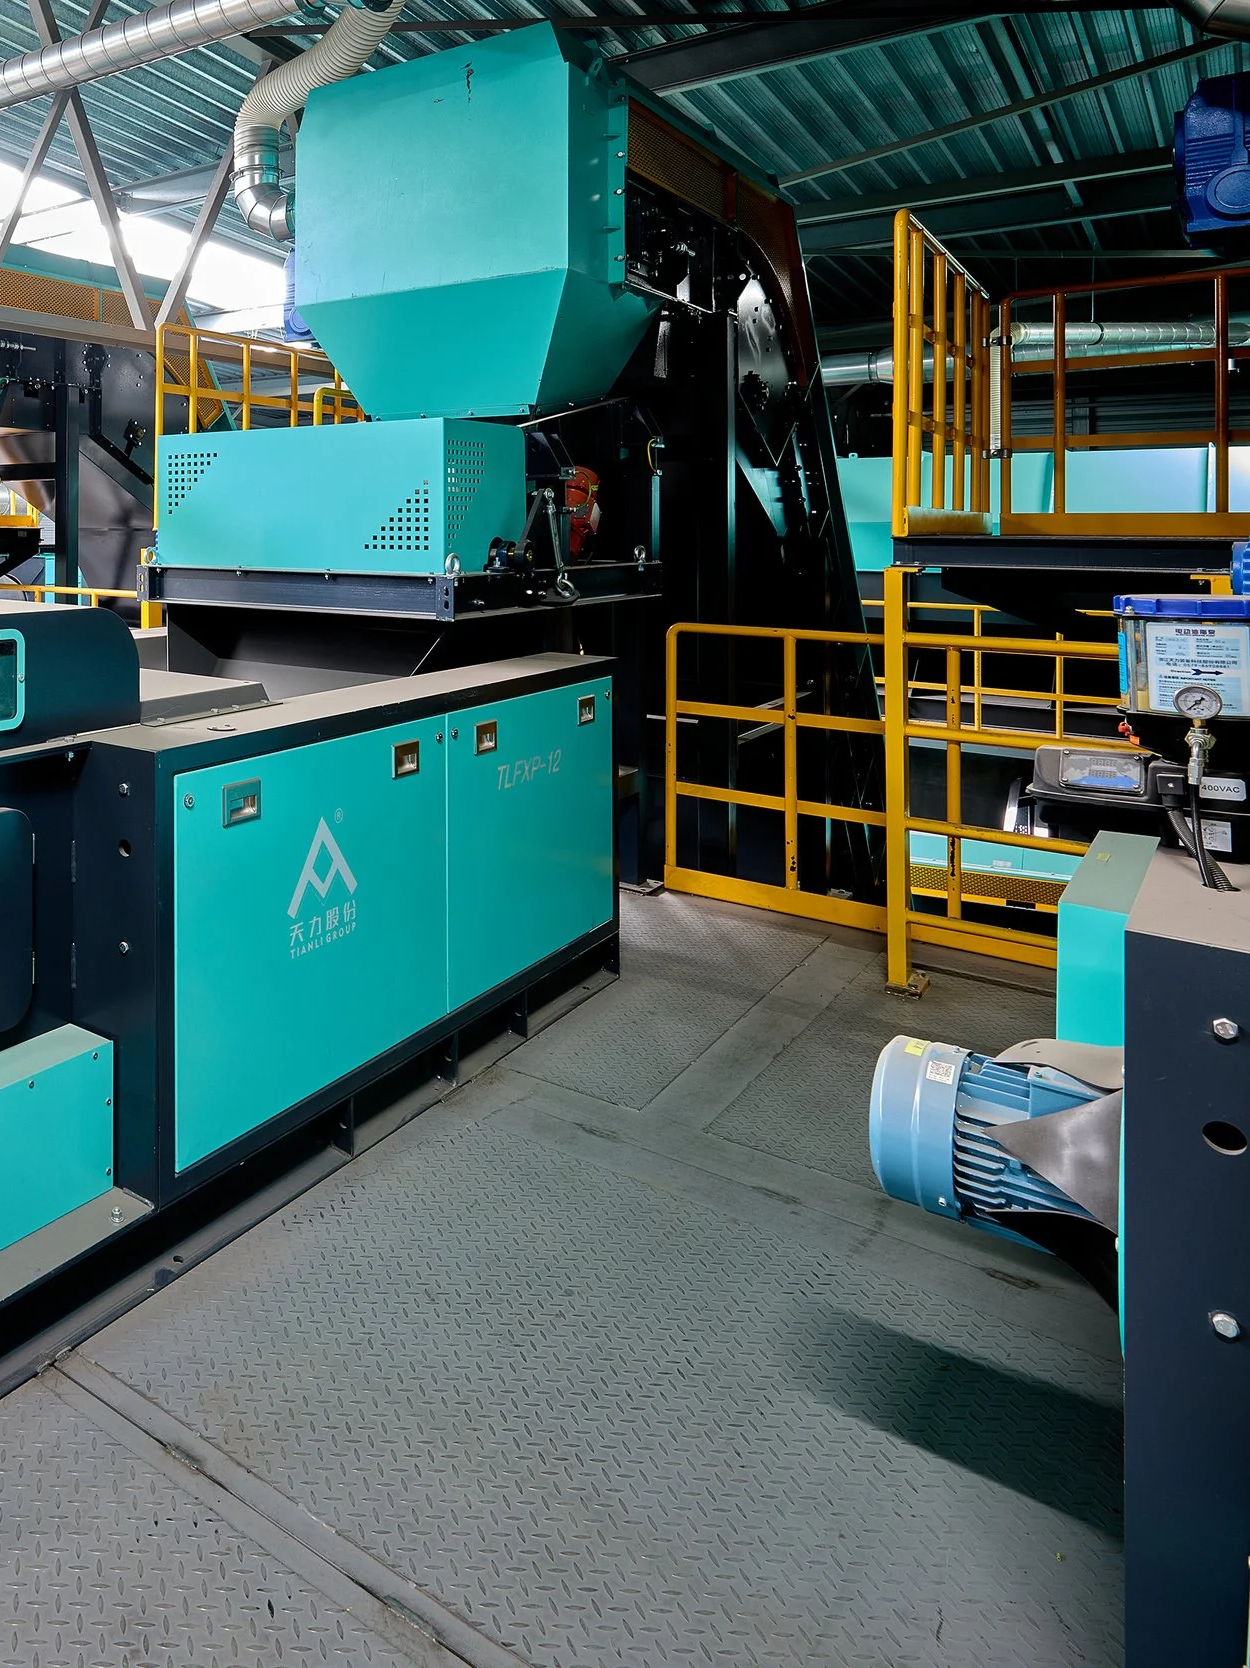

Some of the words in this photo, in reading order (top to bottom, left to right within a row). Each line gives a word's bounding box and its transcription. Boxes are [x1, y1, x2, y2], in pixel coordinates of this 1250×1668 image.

[497, 748, 562, 791] TLFXP-12
[1201, 784, 1240, 793] 400VAC
[289, 899, 357, 947] 天力股份
[290, 936, 324, 959] TIANLI
[326, 922, 357, 943] GROUP
